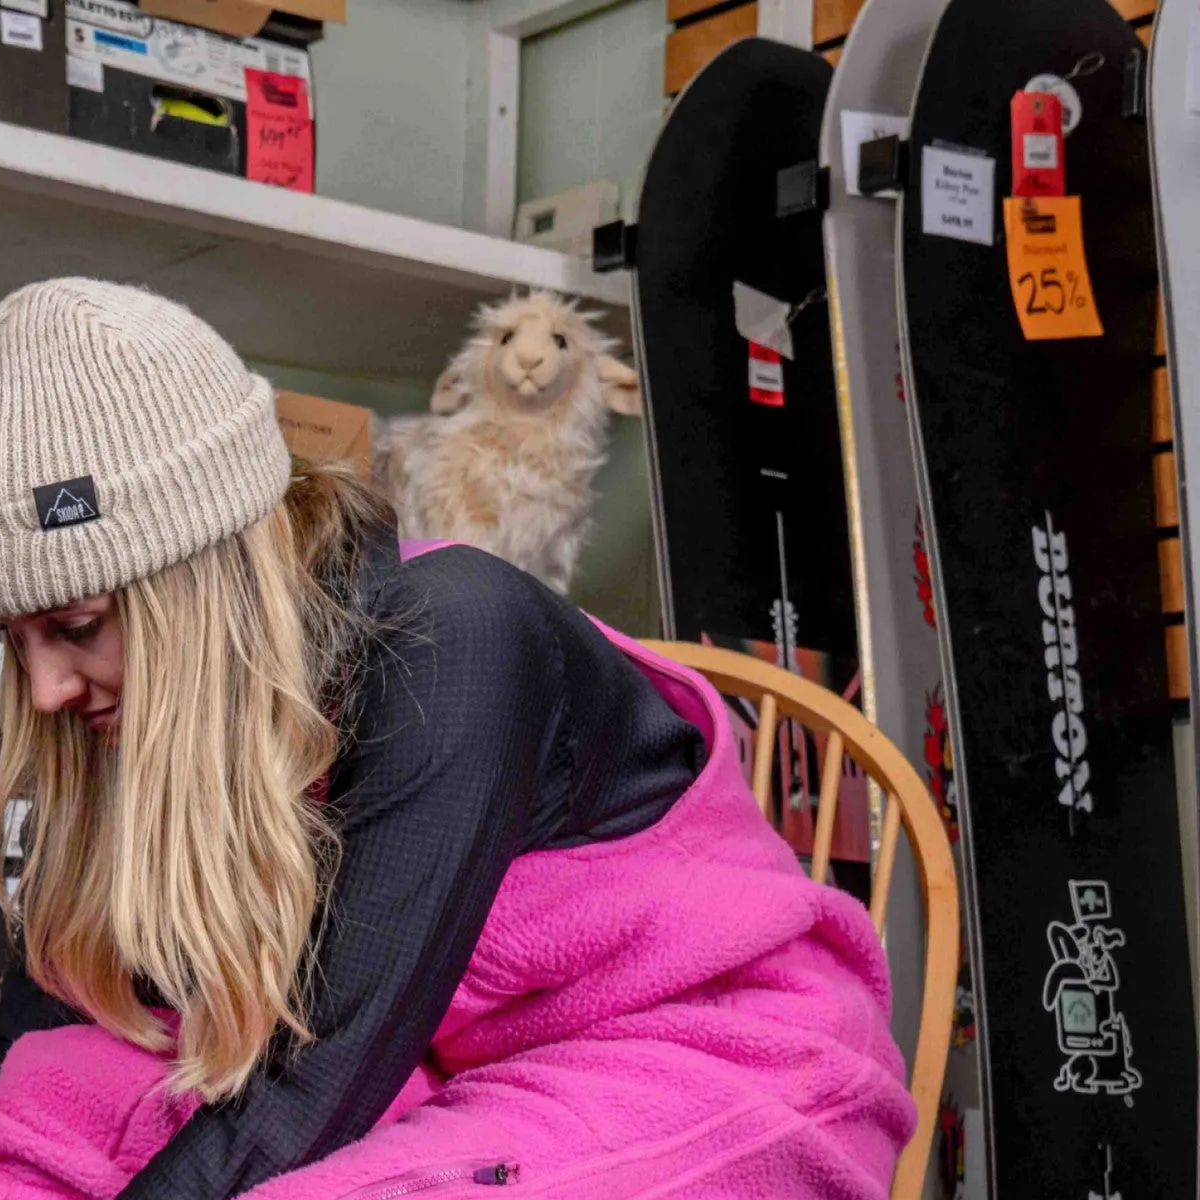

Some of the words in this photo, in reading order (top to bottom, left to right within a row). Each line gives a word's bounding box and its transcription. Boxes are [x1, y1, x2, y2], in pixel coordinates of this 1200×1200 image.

[1018, 268, 1086, 315] 25%
[56, 504, 80, 523] SKIDA
[1032, 525, 1093, 813] BURTON
